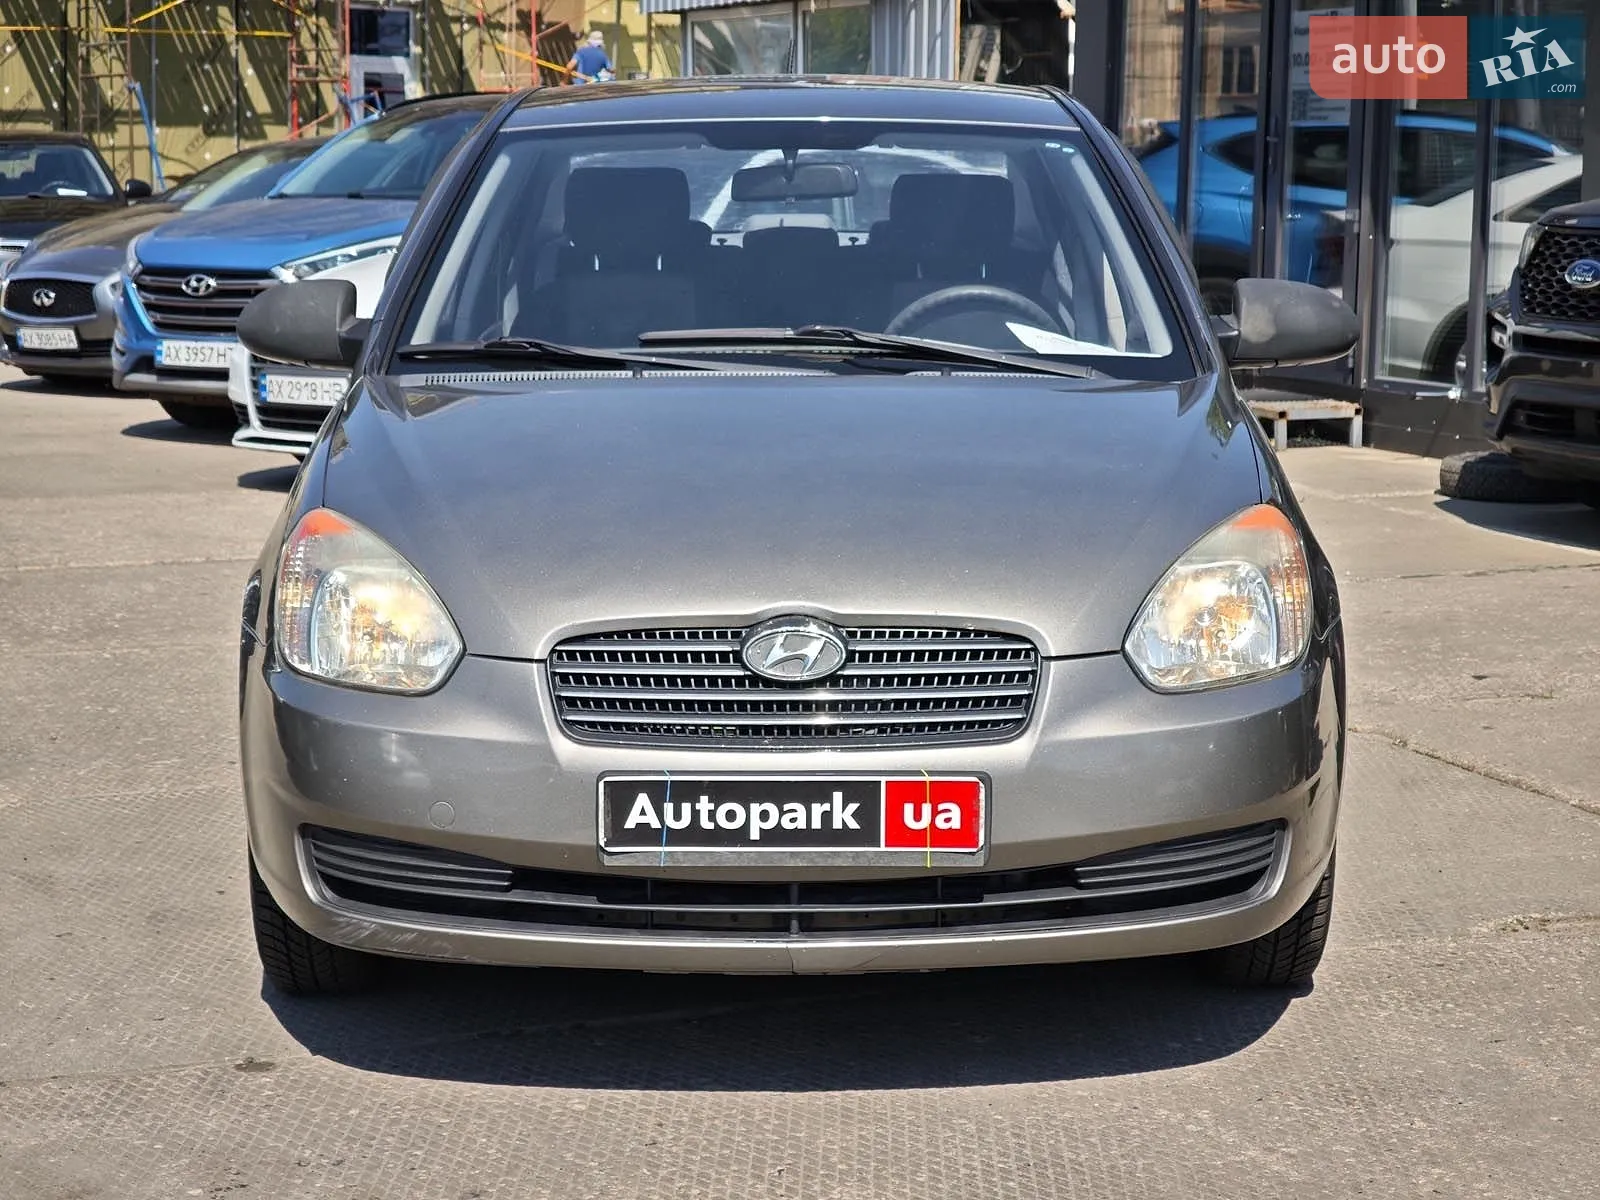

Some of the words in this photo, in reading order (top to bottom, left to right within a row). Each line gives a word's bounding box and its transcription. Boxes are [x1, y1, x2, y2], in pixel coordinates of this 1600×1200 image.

[165, 345, 181, 361] AX
[184, 346, 214, 362] 3957
[268, 380, 284, 399] AX
[288, 381, 317, 401] 2918
[624, 791, 861, 841] Autopark
[903, 801, 962, 830] ua
